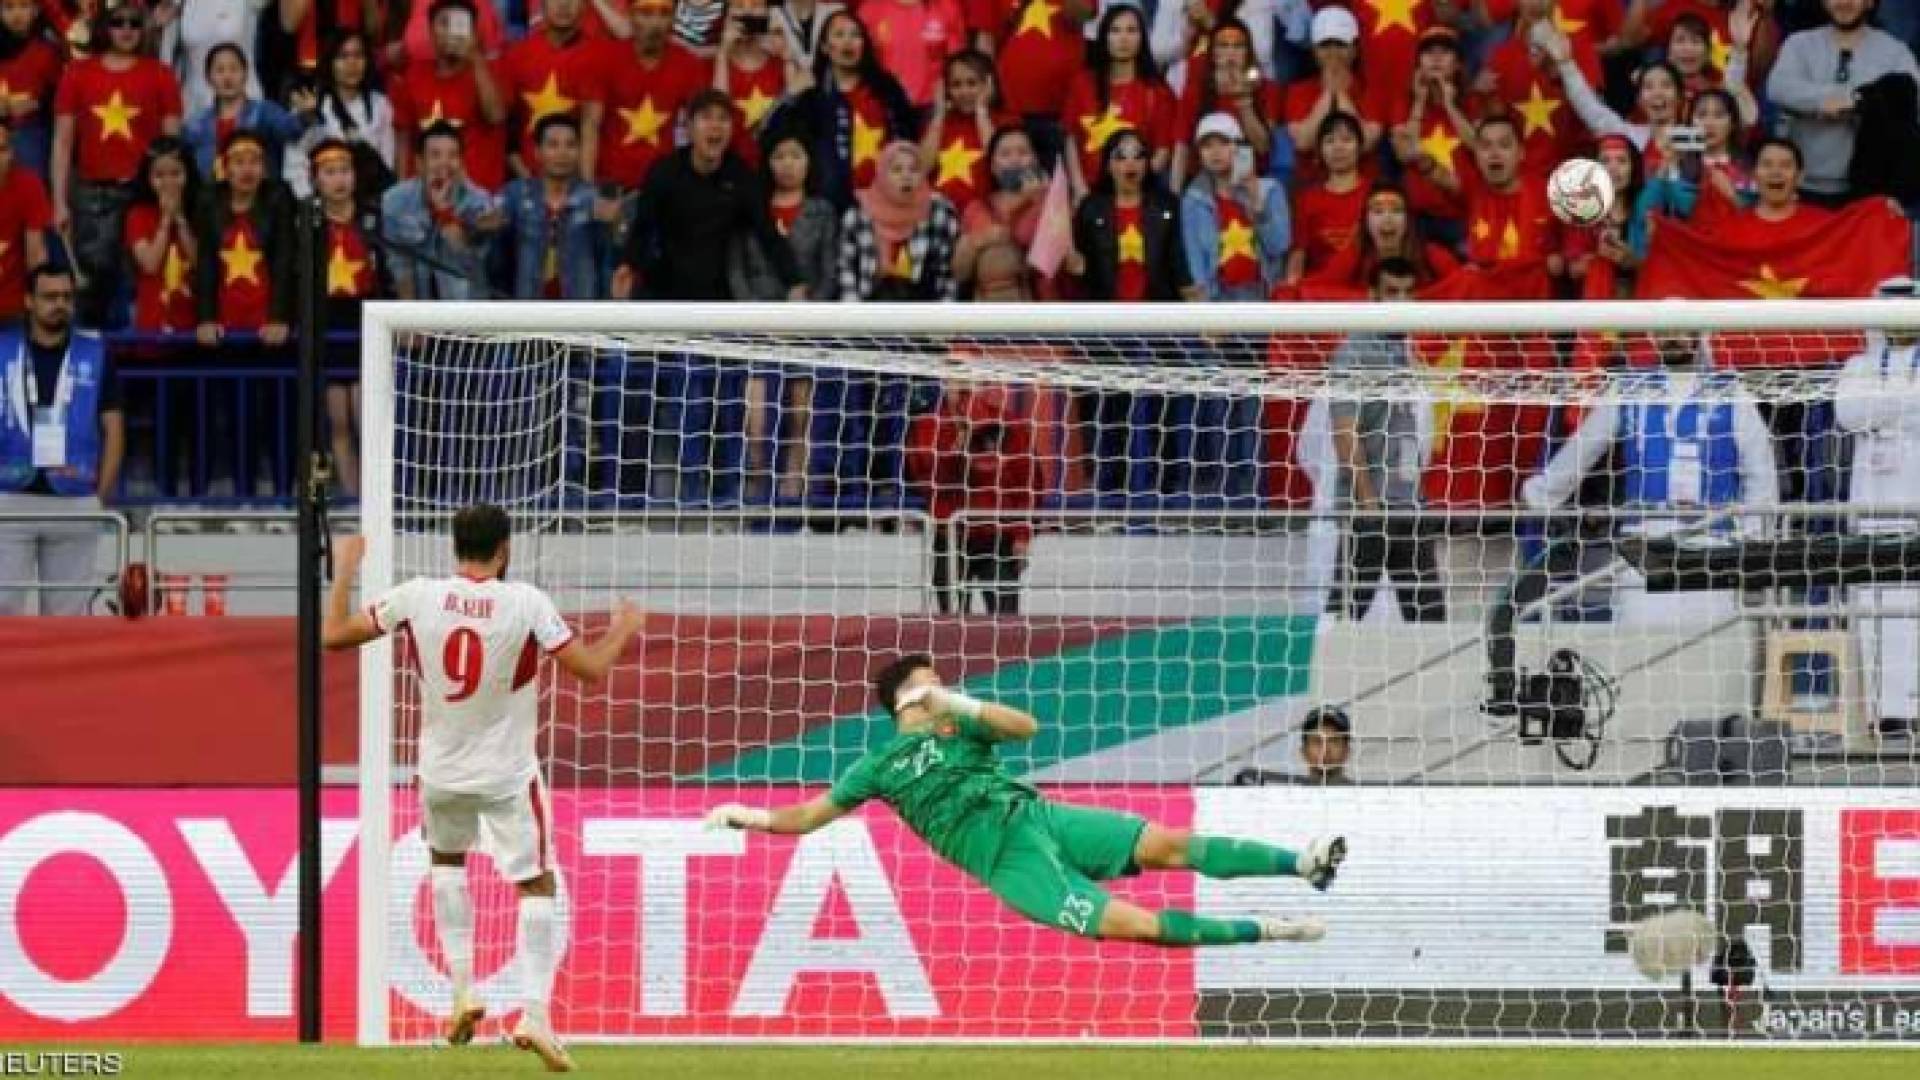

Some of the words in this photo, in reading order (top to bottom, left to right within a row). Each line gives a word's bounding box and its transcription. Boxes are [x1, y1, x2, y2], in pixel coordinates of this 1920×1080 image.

[442, 625, 484, 703] 9
[1058, 893, 1095, 935] 23
[1753, 1002, 1864, 1035] Japan's
